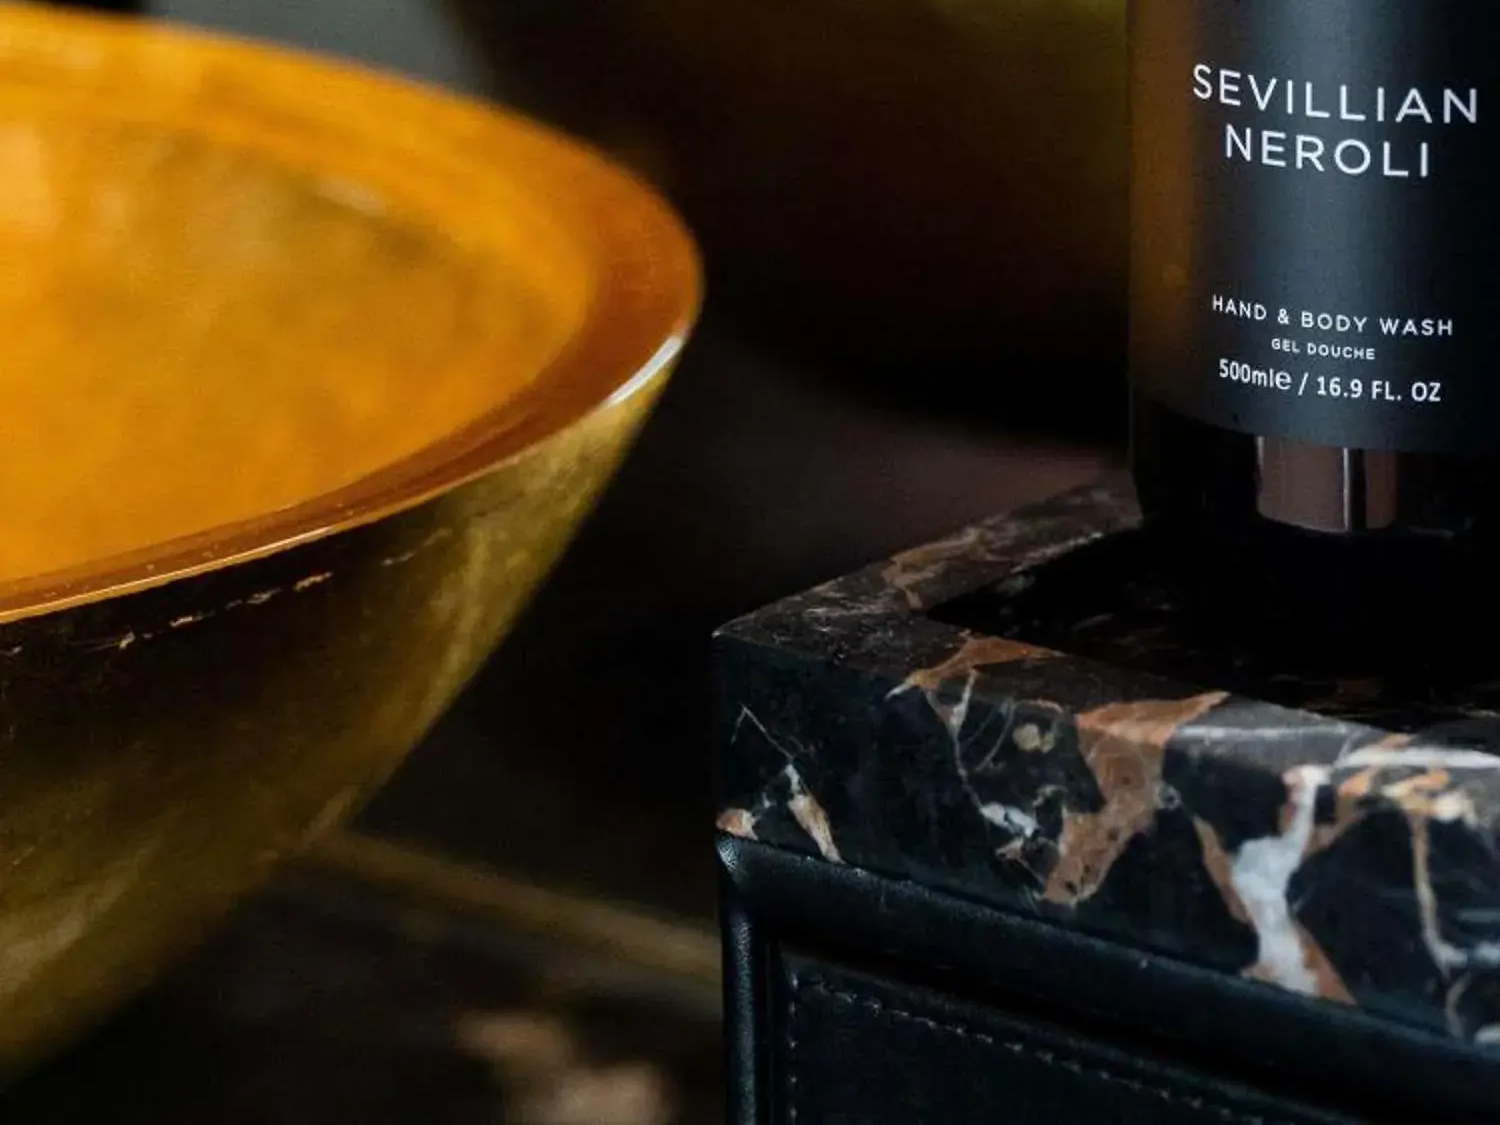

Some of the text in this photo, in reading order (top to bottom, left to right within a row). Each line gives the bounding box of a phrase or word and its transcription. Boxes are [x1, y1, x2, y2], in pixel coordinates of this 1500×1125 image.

[1192, 63, 1478, 124] SEVILLIAN
[1225, 122, 1429, 178] NEROLI
[1211, 294, 1454, 337] HAND & BODY WASH
[1271, 337, 1376, 361] GEL DOUCHE
[1316, 375, 1363, 399] 16.9
[1371, 379, 1403, 402] FL.
[1411, 381, 1442, 403] OZ
